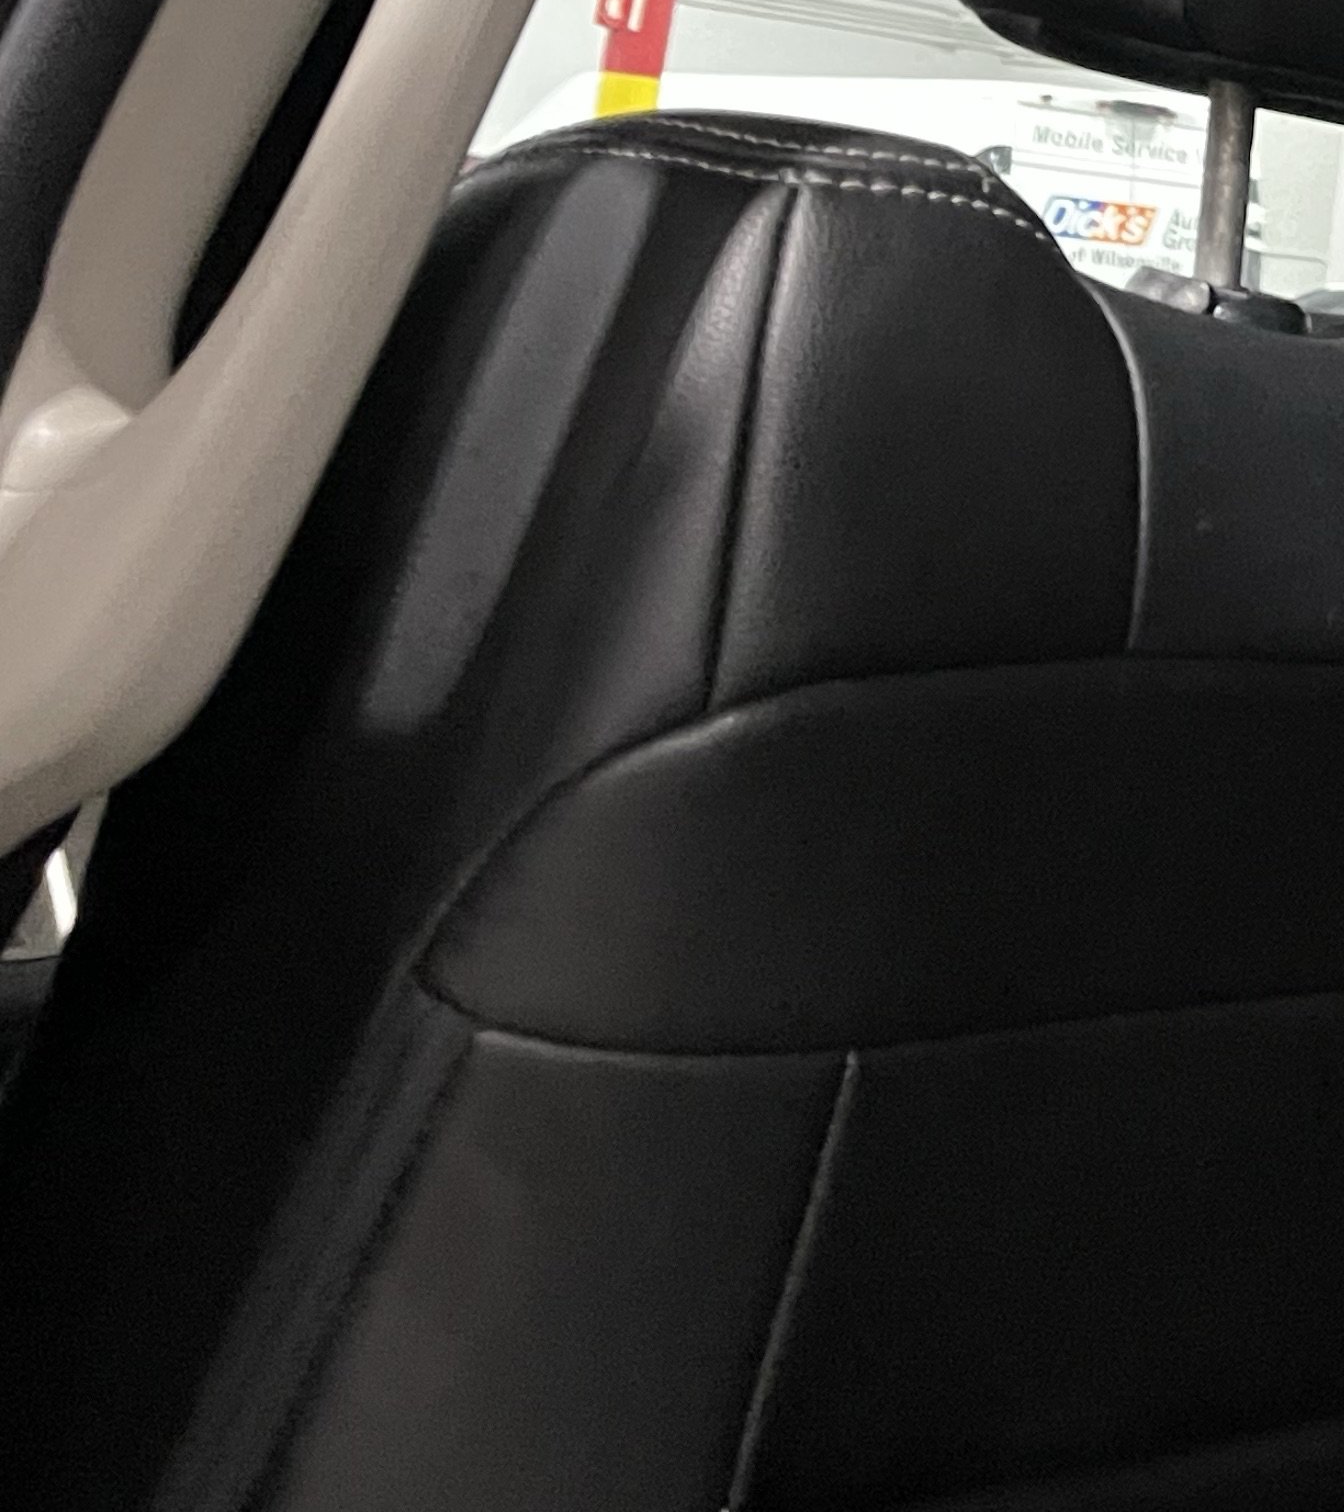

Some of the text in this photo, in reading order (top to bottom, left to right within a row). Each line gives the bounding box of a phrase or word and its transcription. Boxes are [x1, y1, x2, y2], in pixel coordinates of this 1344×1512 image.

[1032, 125, 1104, 152] Mobile
[1112, 135, 1188, 164] Service
[1043, 198, 1148, 244] Dick's
[1171, 209, 1199, 231] Au
